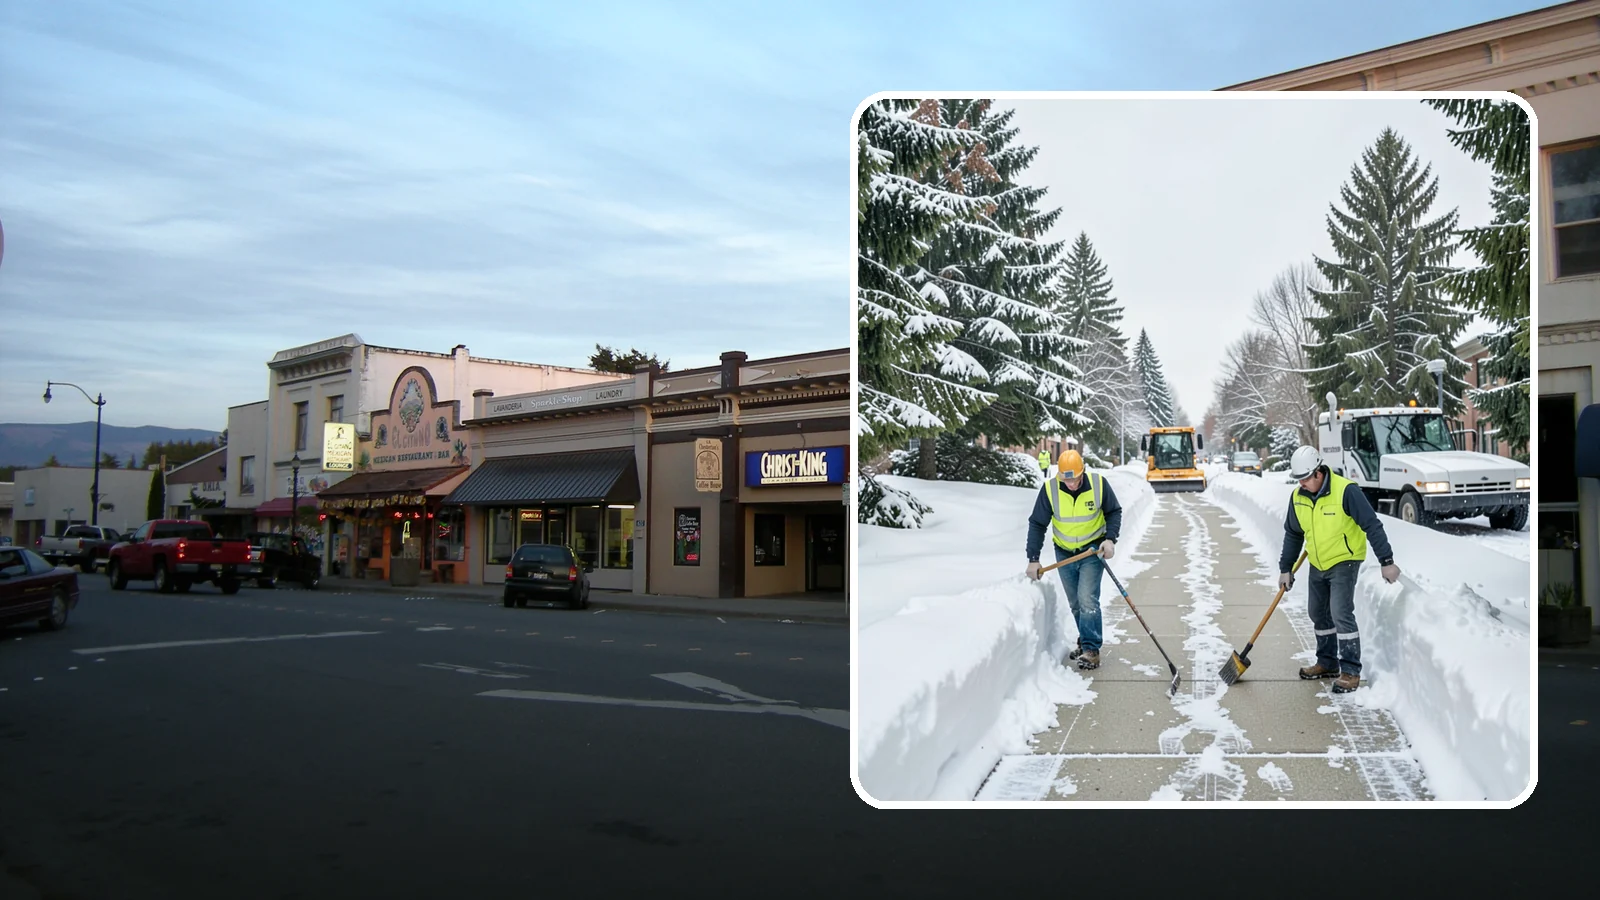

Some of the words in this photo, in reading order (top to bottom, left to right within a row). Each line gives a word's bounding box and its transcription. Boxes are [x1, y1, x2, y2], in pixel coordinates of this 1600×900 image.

[562, 394, 582, 404] Shop
[596, 389, 624, 400] LAUNDRY
[373, 456, 396, 464] MEXICAN
[397, 452, 433, 462] RESTAURANT
[438, 450, 450, 459] BAR
[761, 452, 797, 478] CHRIST
[799, 450, 827, 476] KING
